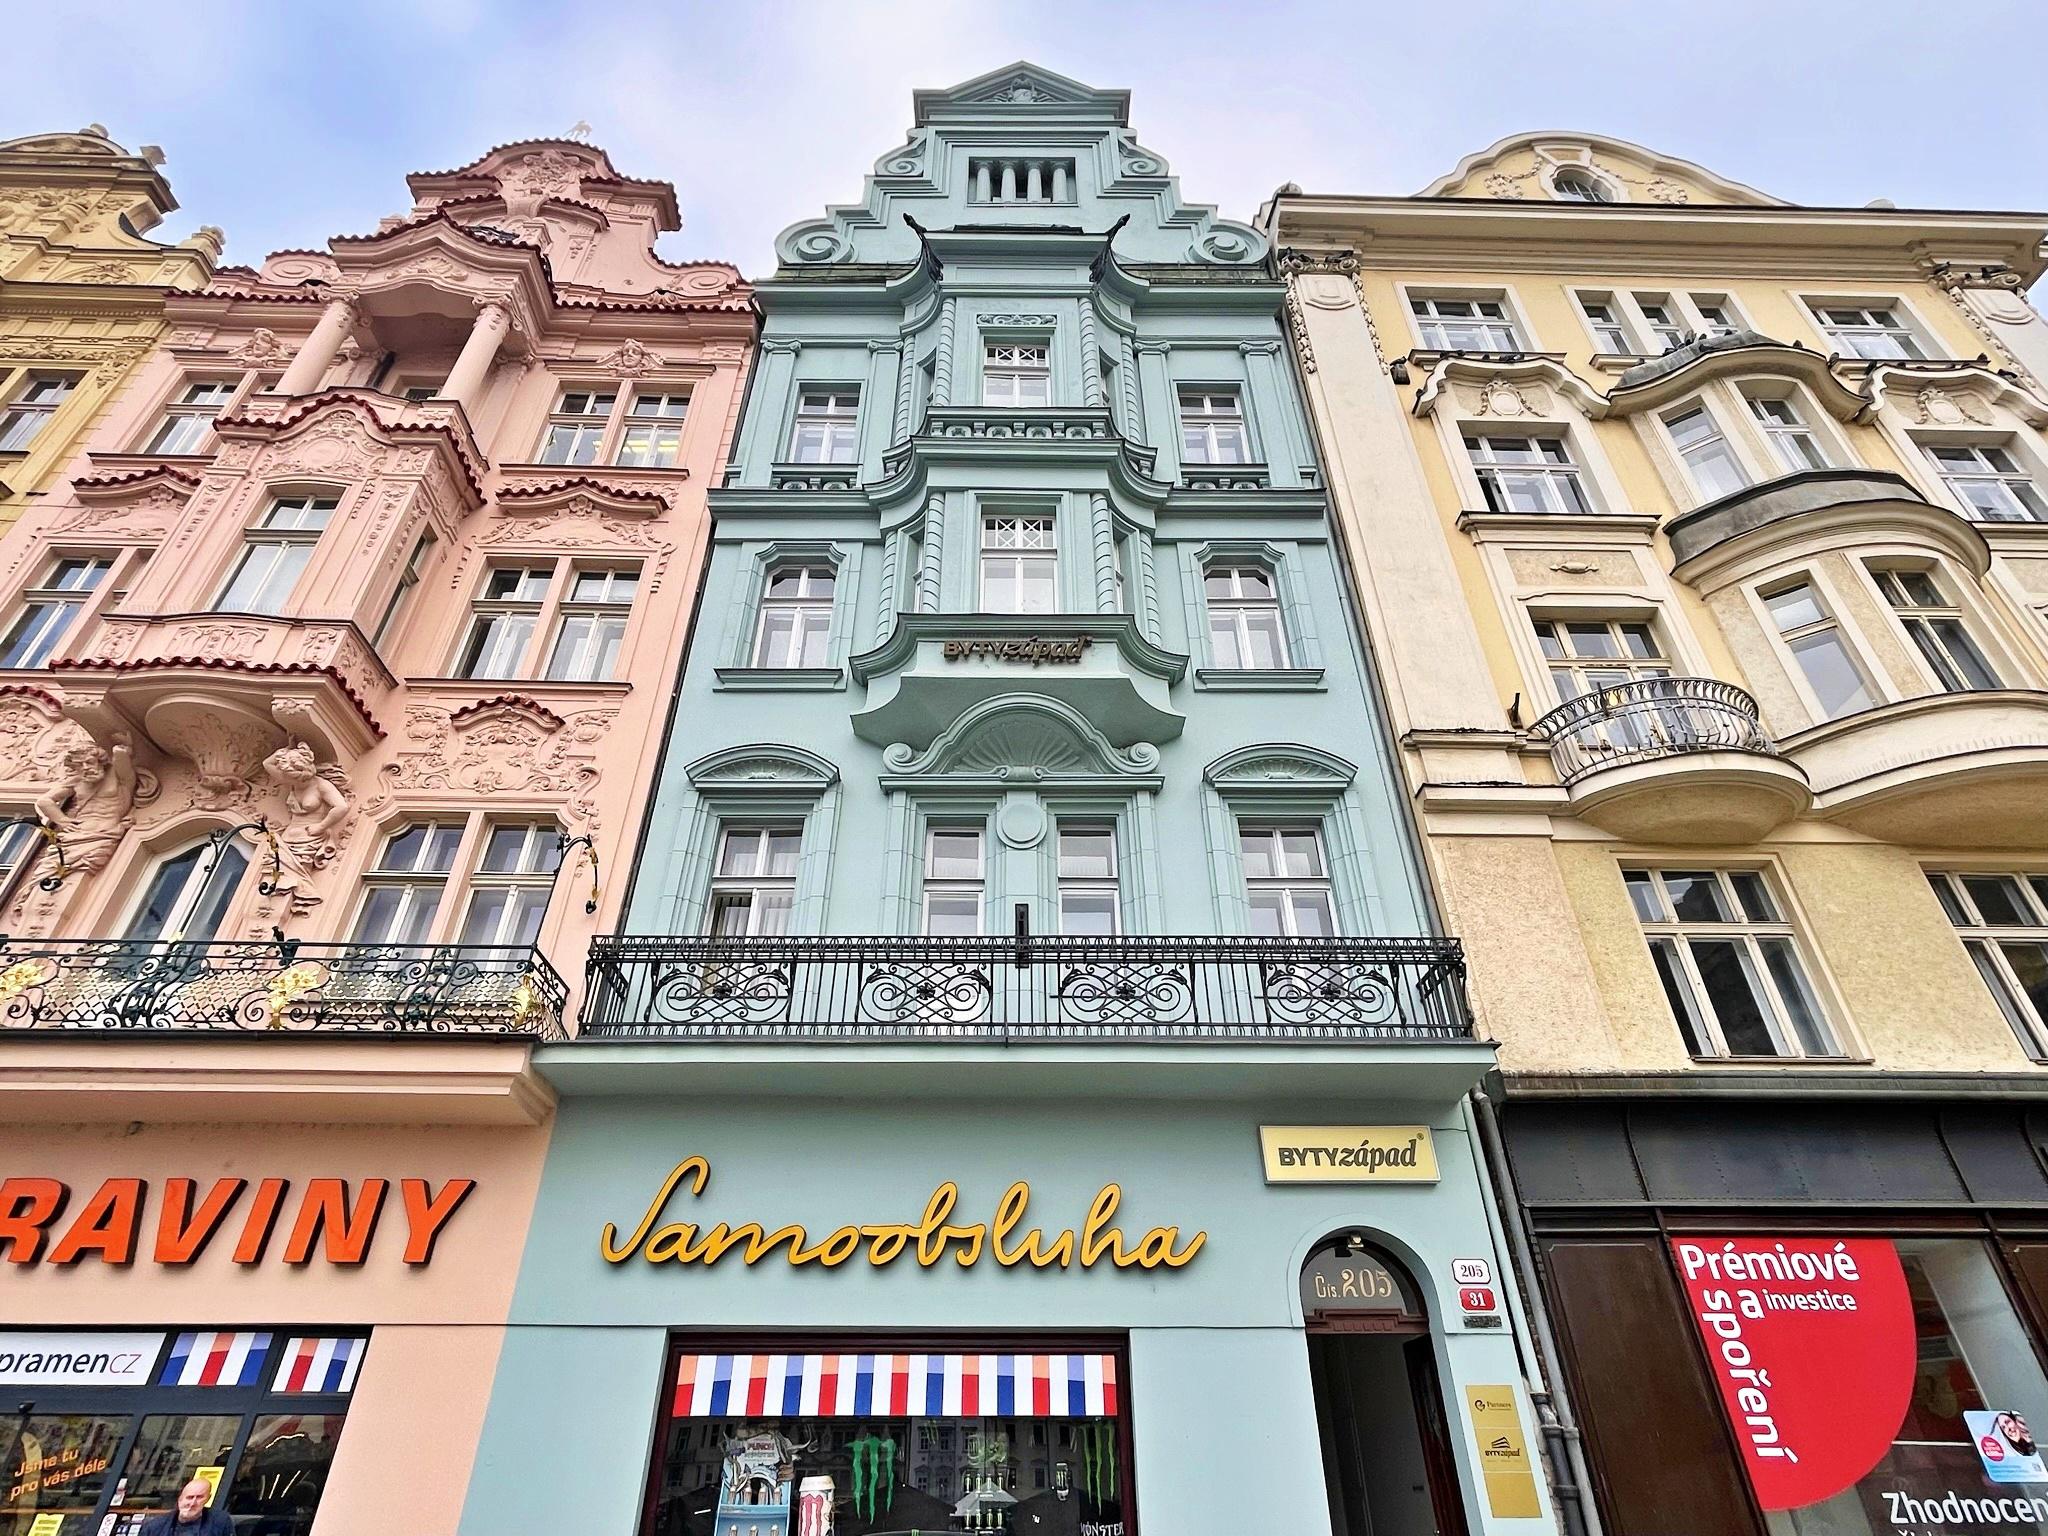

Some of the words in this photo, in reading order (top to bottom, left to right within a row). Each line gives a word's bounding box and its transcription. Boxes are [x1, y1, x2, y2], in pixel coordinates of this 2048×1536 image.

[1278, 1139, 1417, 1173] BYTYzápad
[0, 1177, 477, 1265] RAVINY
[600, 1155, 1208, 1267] Samoobsluha
[1460, 1264, 1484, 1278] 205
[1678, 1241, 1860, 1282] Prémiové
[1341, 1269, 1392, 1298] 205
[1468, 1291, 1487, 1307] 31
[1736, 1288, 1766, 1319] a
[1763, 1288, 1858, 1312] investice
[1701, 1288, 1799, 1465] spoření
[9, 1481, 39, 1502] pro
[43, 1469, 70, 1488] vás
[74, 1457, 108, 1479] déle
[14, 1455, 58, 1478] Jsme
[61, 1447, 79, 1462] tu
[1881, 1490, 2048, 1524] Zhodnocen
